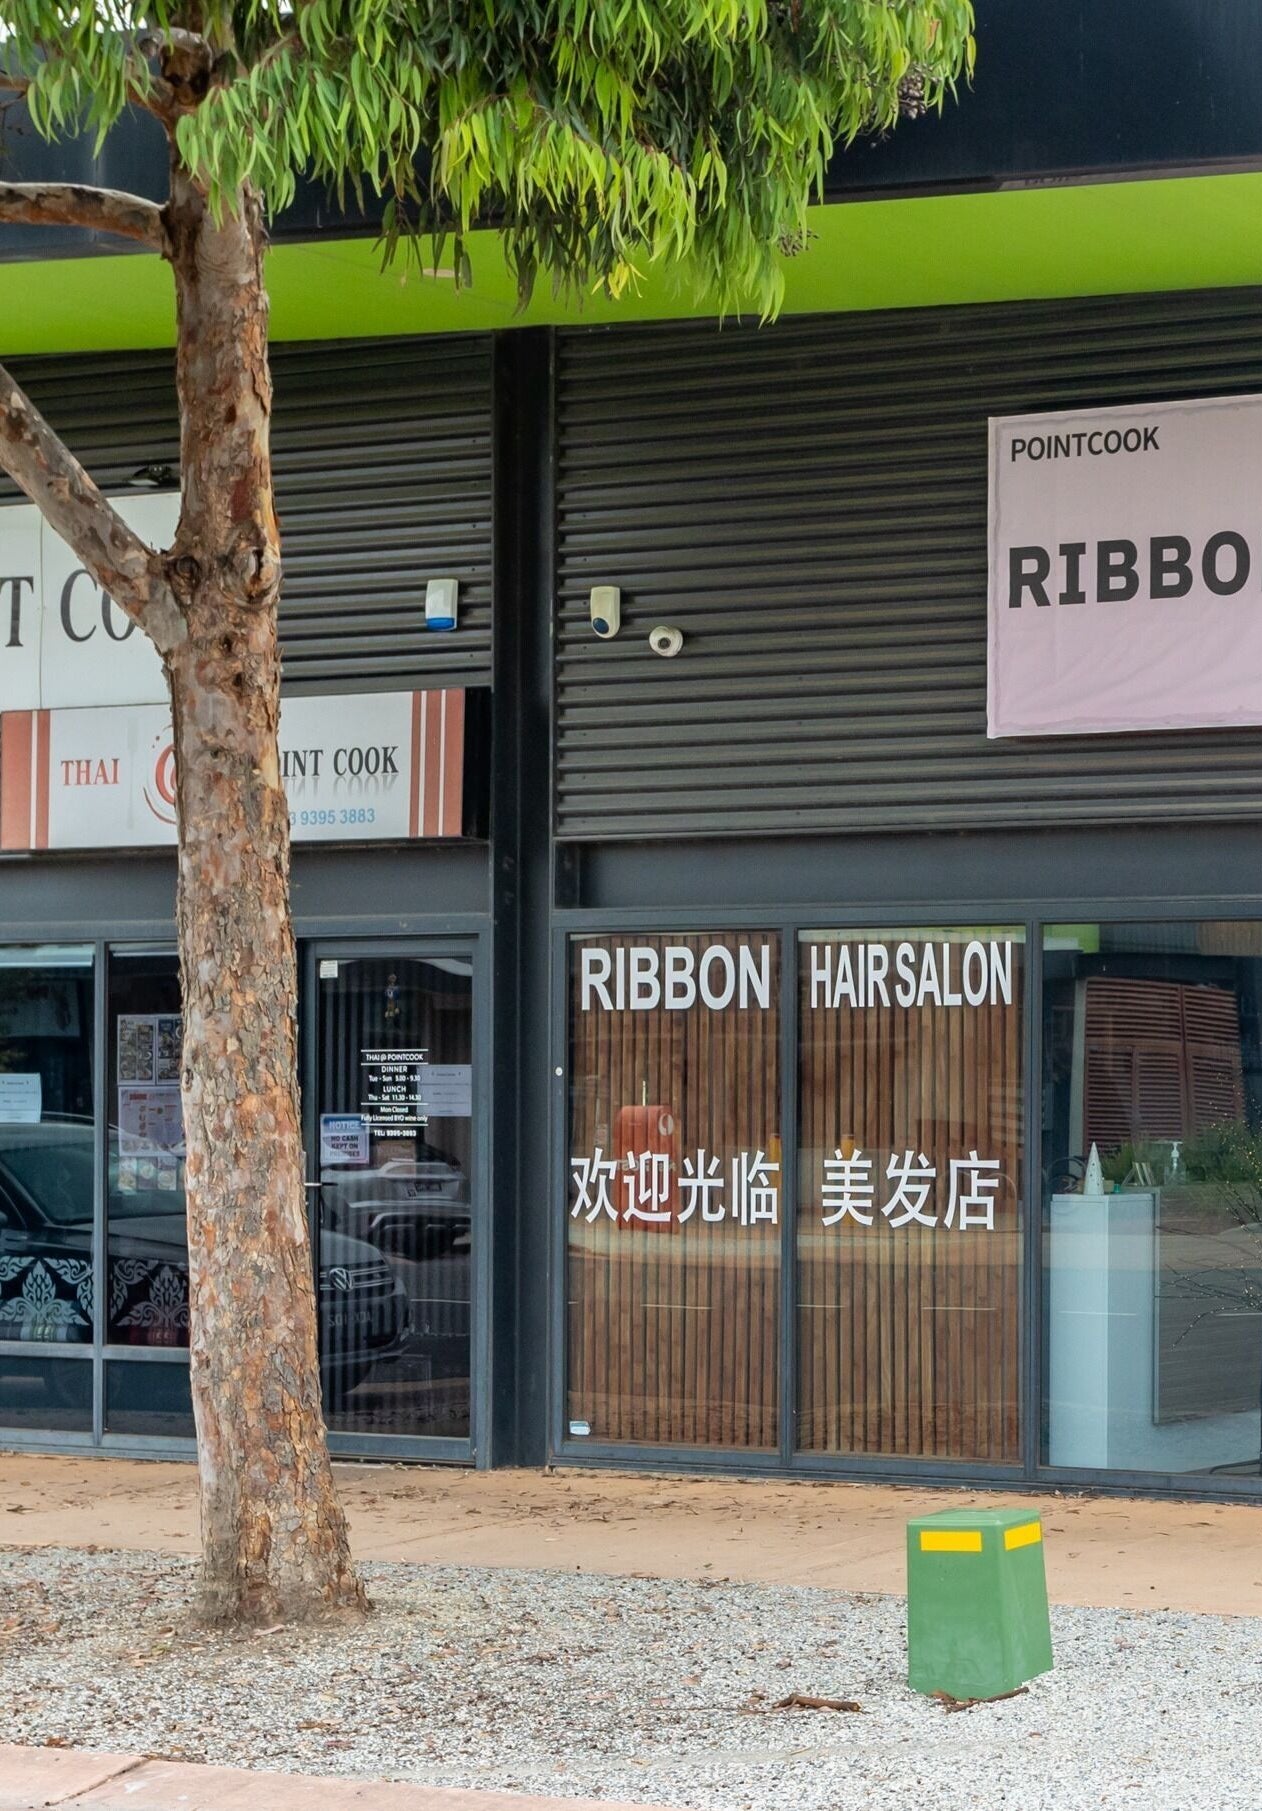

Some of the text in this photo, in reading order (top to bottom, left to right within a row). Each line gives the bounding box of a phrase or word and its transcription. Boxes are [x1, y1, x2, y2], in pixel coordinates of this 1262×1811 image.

[1011, 427, 1159, 462] POINTCOOK
[60, 758, 120, 786] THAI
[333, 746, 399, 776] COOK
[300, 809, 336, 825] 9395
[339, 808, 375, 823] 3883
[581, 945, 770, 1010] RIBBON
[388, 1053, 424, 1061] POINTCOOK
[329, 1121, 361, 1130] NOTICE
[570, 1148, 1001, 1231] 欢迎光临 美发店
